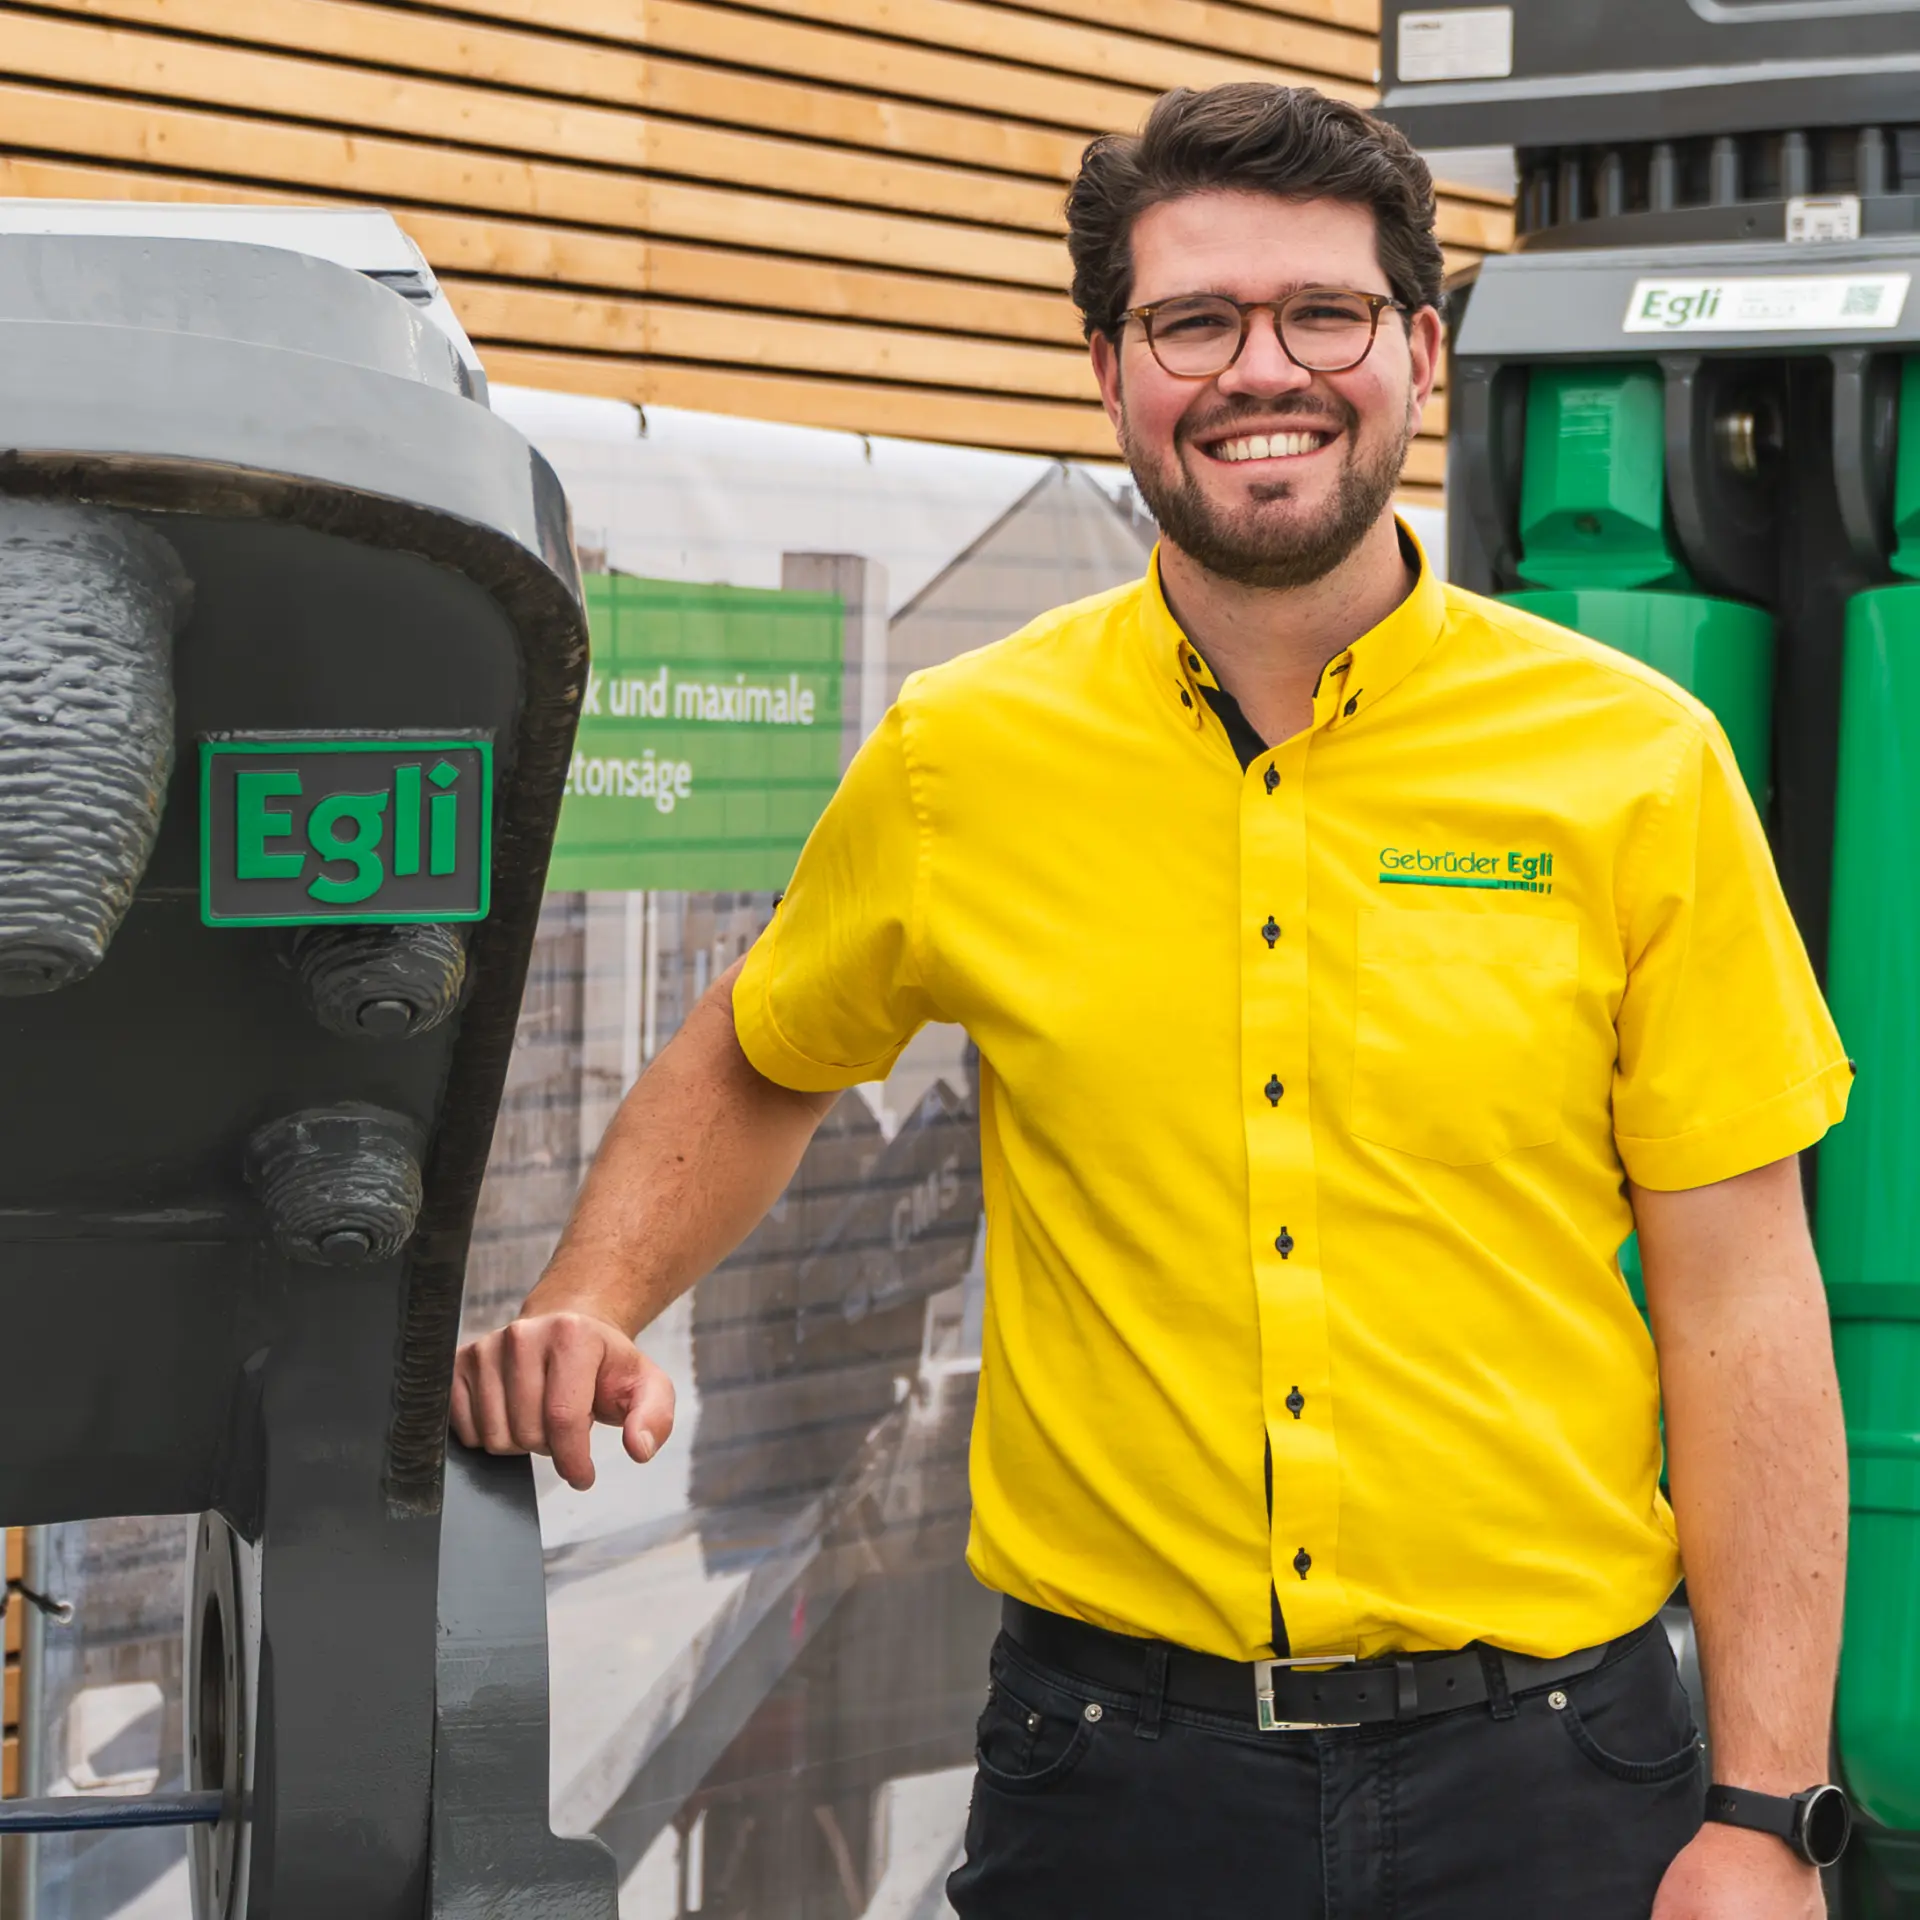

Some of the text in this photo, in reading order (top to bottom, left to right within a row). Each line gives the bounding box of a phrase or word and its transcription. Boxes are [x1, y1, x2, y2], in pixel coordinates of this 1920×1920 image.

[1640, 286, 1722, 328] Egli
[609, 664, 668, 718] und
[675, 672, 815, 725] maximale
[236, 759, 460, 904] Egli
[1379, 848, 1554, 880] Gebrüder Egli
